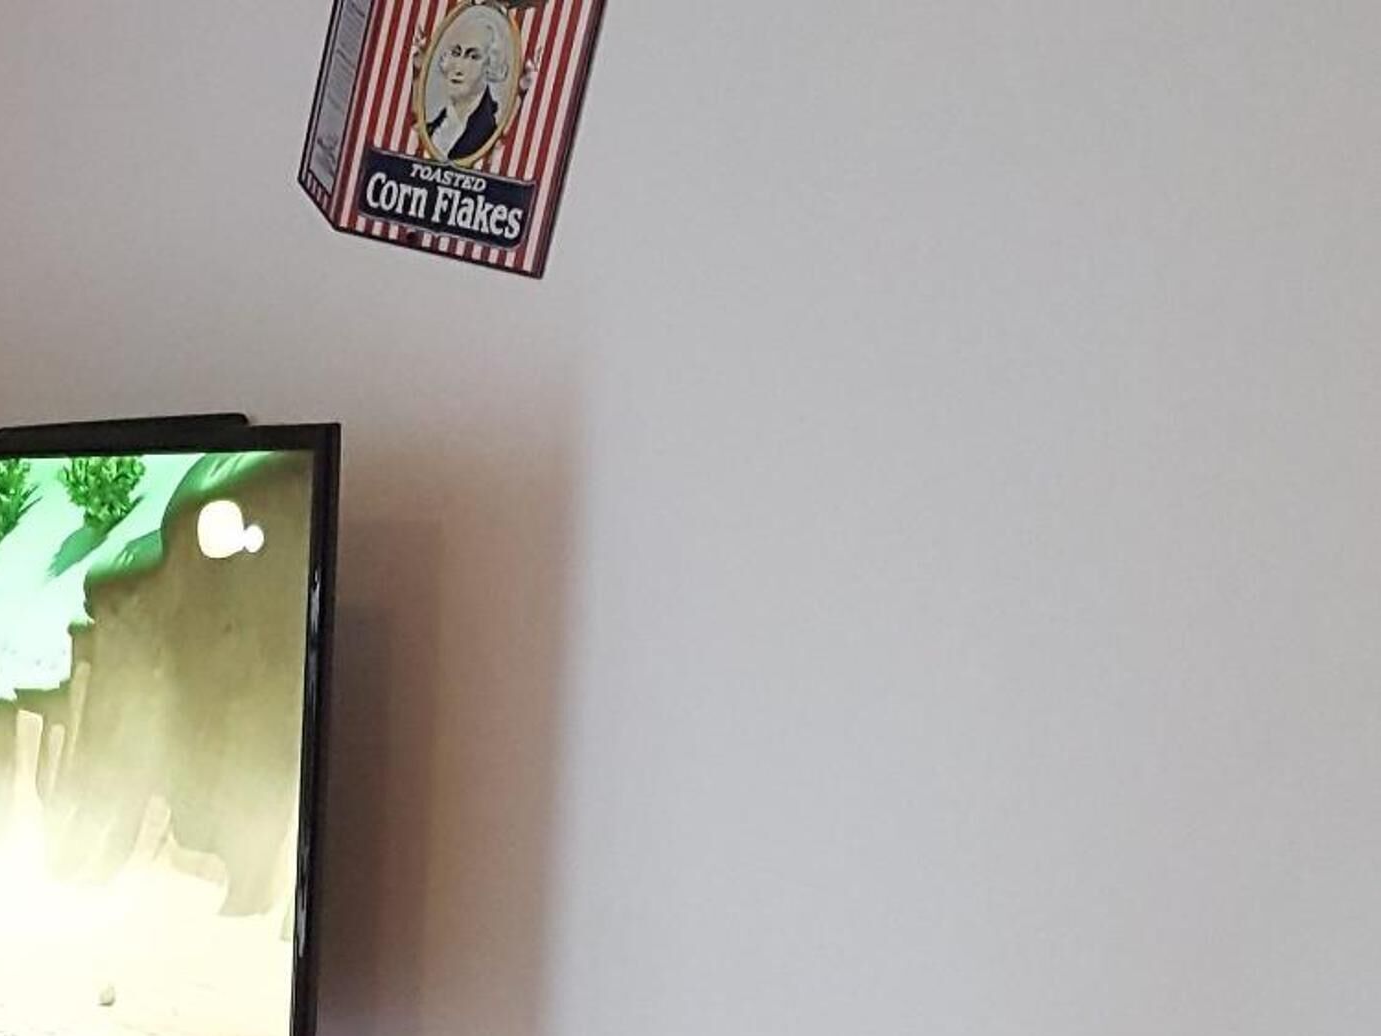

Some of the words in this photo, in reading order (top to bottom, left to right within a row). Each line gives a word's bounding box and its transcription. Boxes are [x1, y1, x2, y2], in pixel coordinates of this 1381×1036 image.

[410, 164, 486, 192] TOASTED
[366, 172, 427, 218] Corn
[431, 185, 523, 240] Flakes
